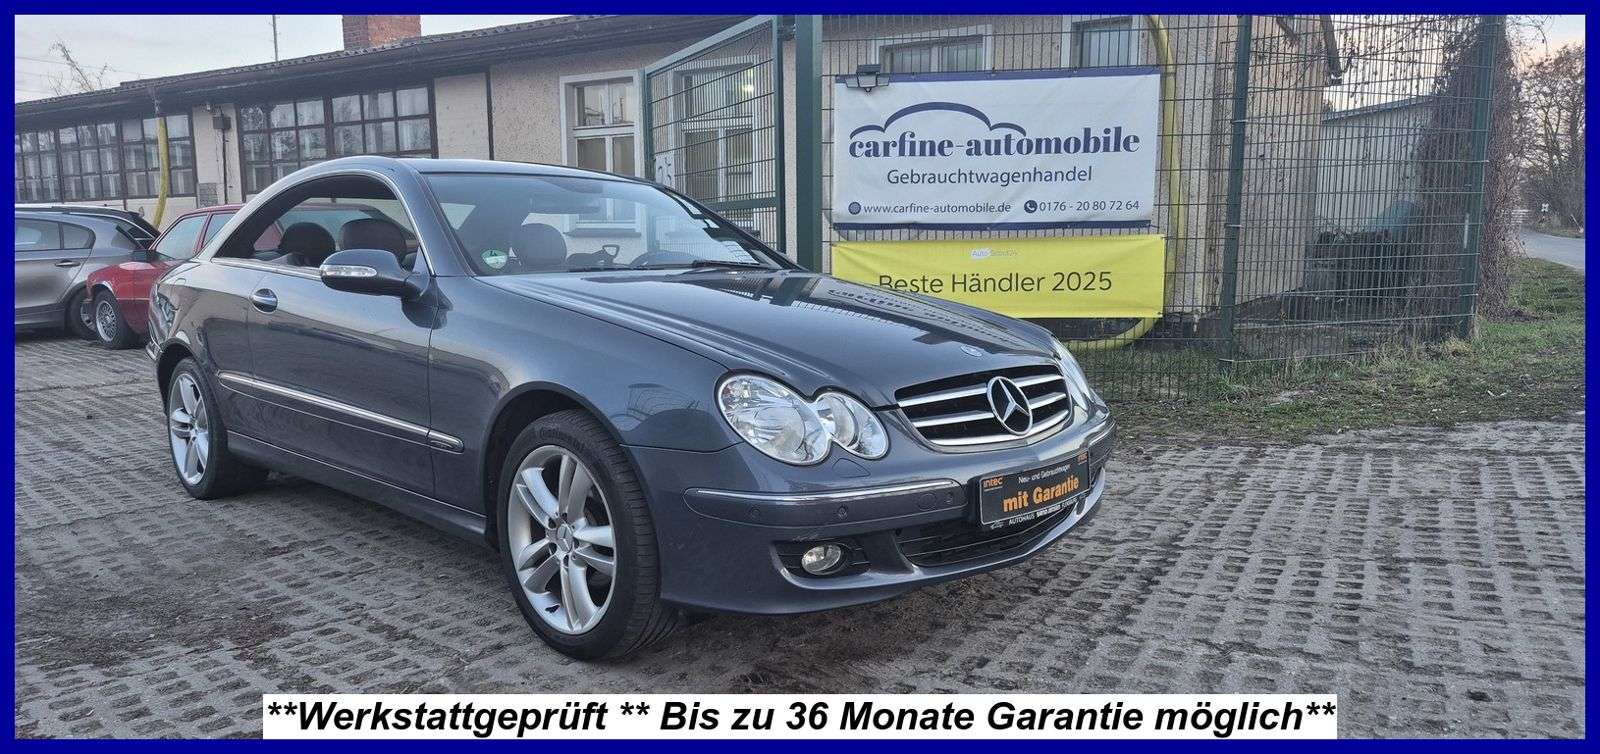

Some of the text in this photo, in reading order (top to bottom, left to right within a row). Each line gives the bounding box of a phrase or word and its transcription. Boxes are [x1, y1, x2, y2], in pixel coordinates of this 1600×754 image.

[849, 126, 1140, 158] carfine-automobile
[887, 166, 1093, 186] Gebrauchtwagenhandel
[863, 201, 1011, 214] www.carfine-automobile.de
[1039, 200, 1067, 212] 0176
[1076, 200, 1090, 212] 20
[1092, 200, 1106, 211] 80
[1109, 200, 1123, 211] 72
[1125, 199, 1140, 211] 64
[952, 273, 1046, 293] Händler
[1052, 271, 1112, 291] 2025
[1003, 491, 1029, 512] mit
[1033, 474, 1080, 504] Garantie
